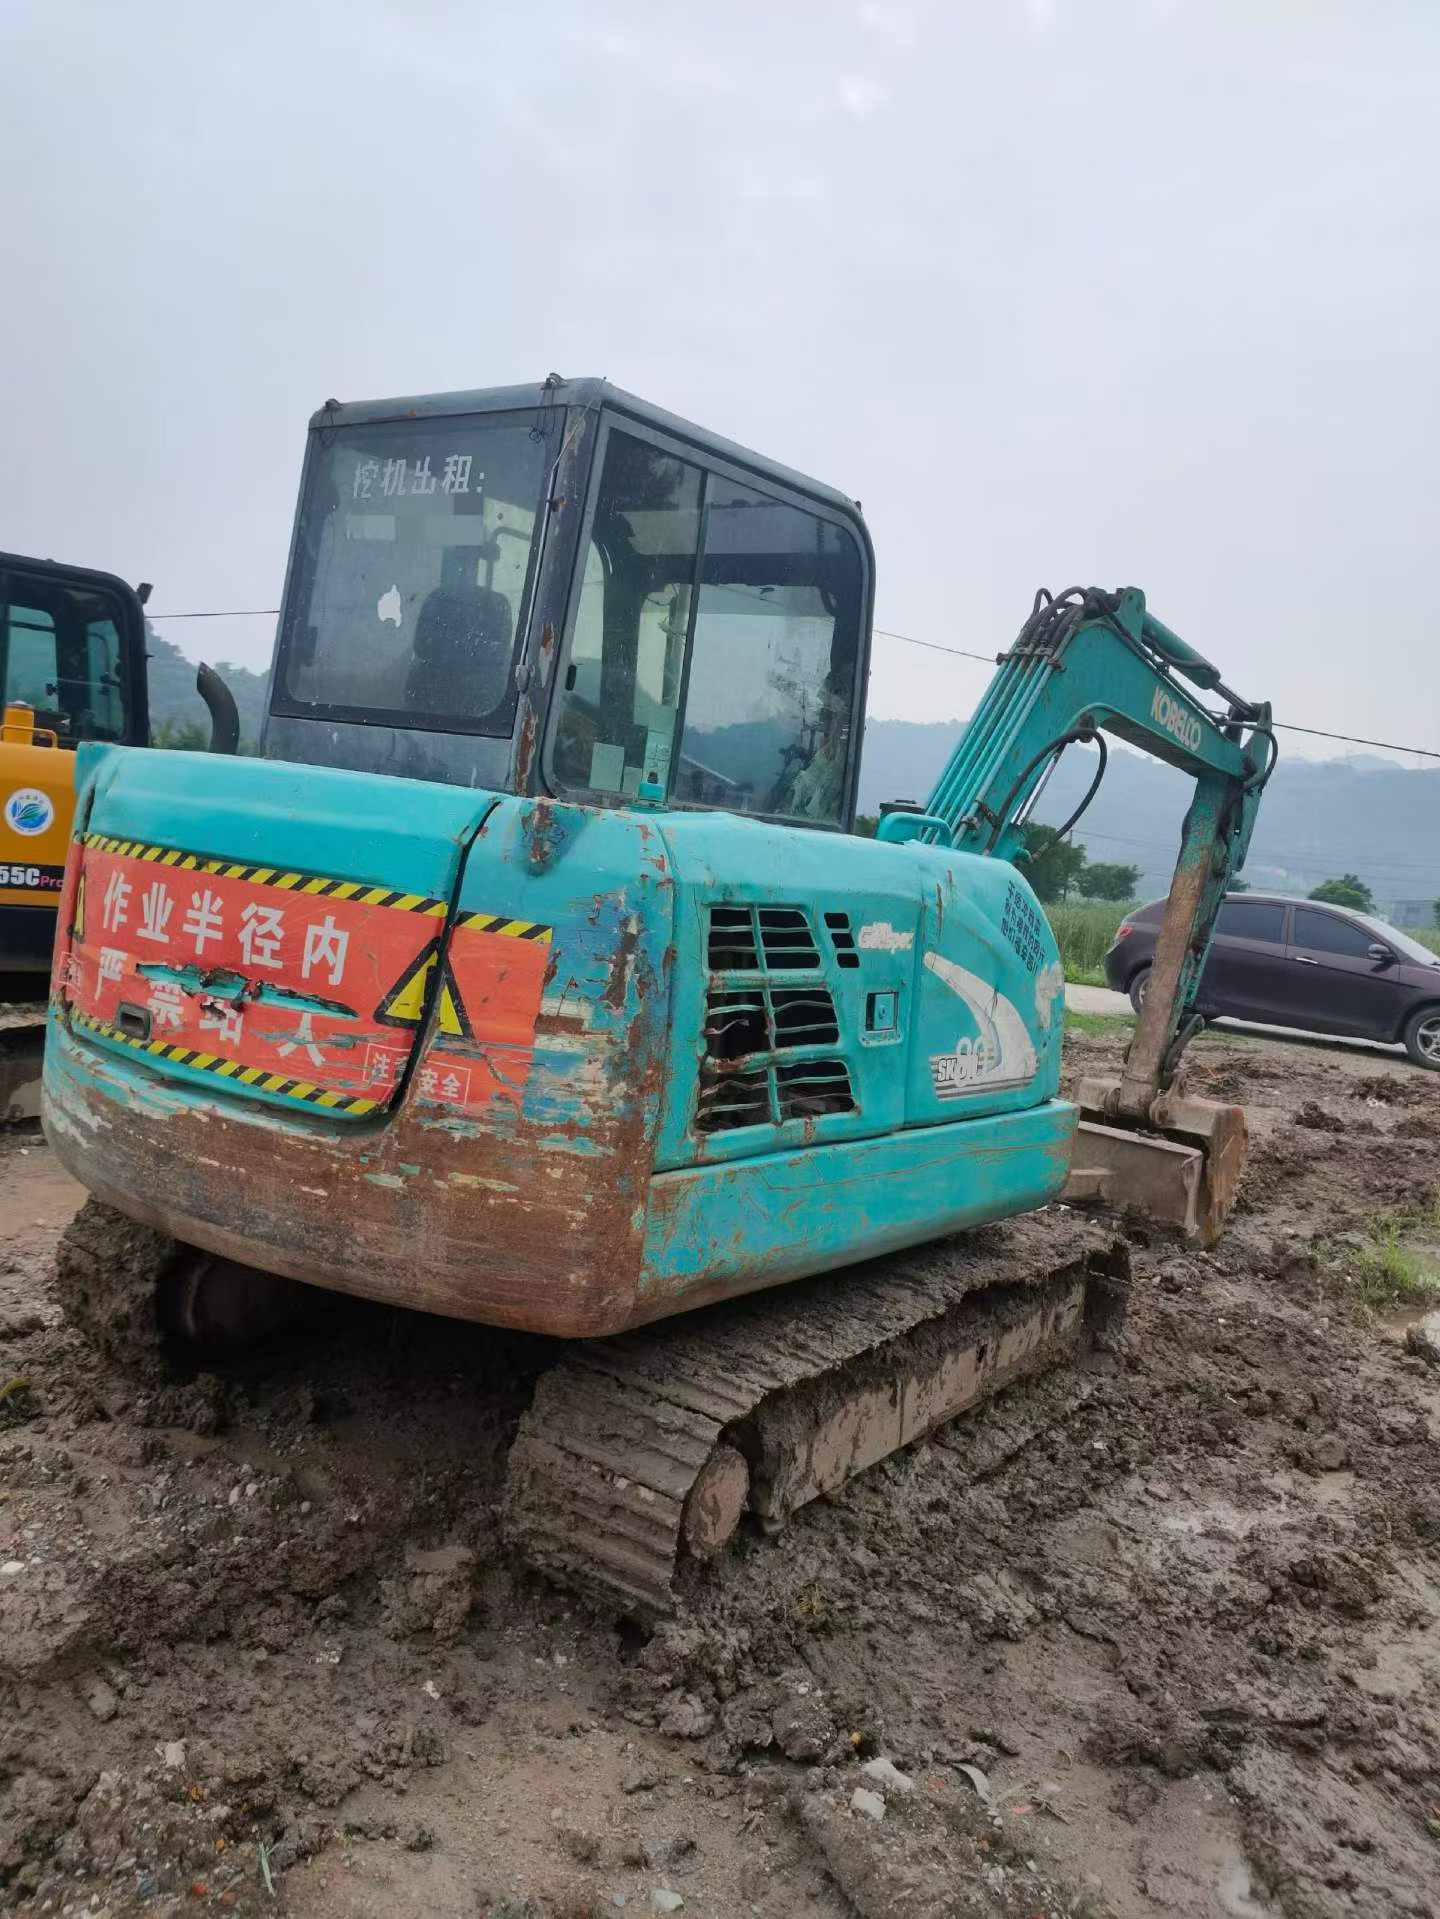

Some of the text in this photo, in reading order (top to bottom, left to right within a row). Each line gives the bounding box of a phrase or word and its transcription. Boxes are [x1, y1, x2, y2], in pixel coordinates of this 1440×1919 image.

[1151, 685, 1202, 753] KOBELCO
[102, 869, 350, 986] 作业半径内
